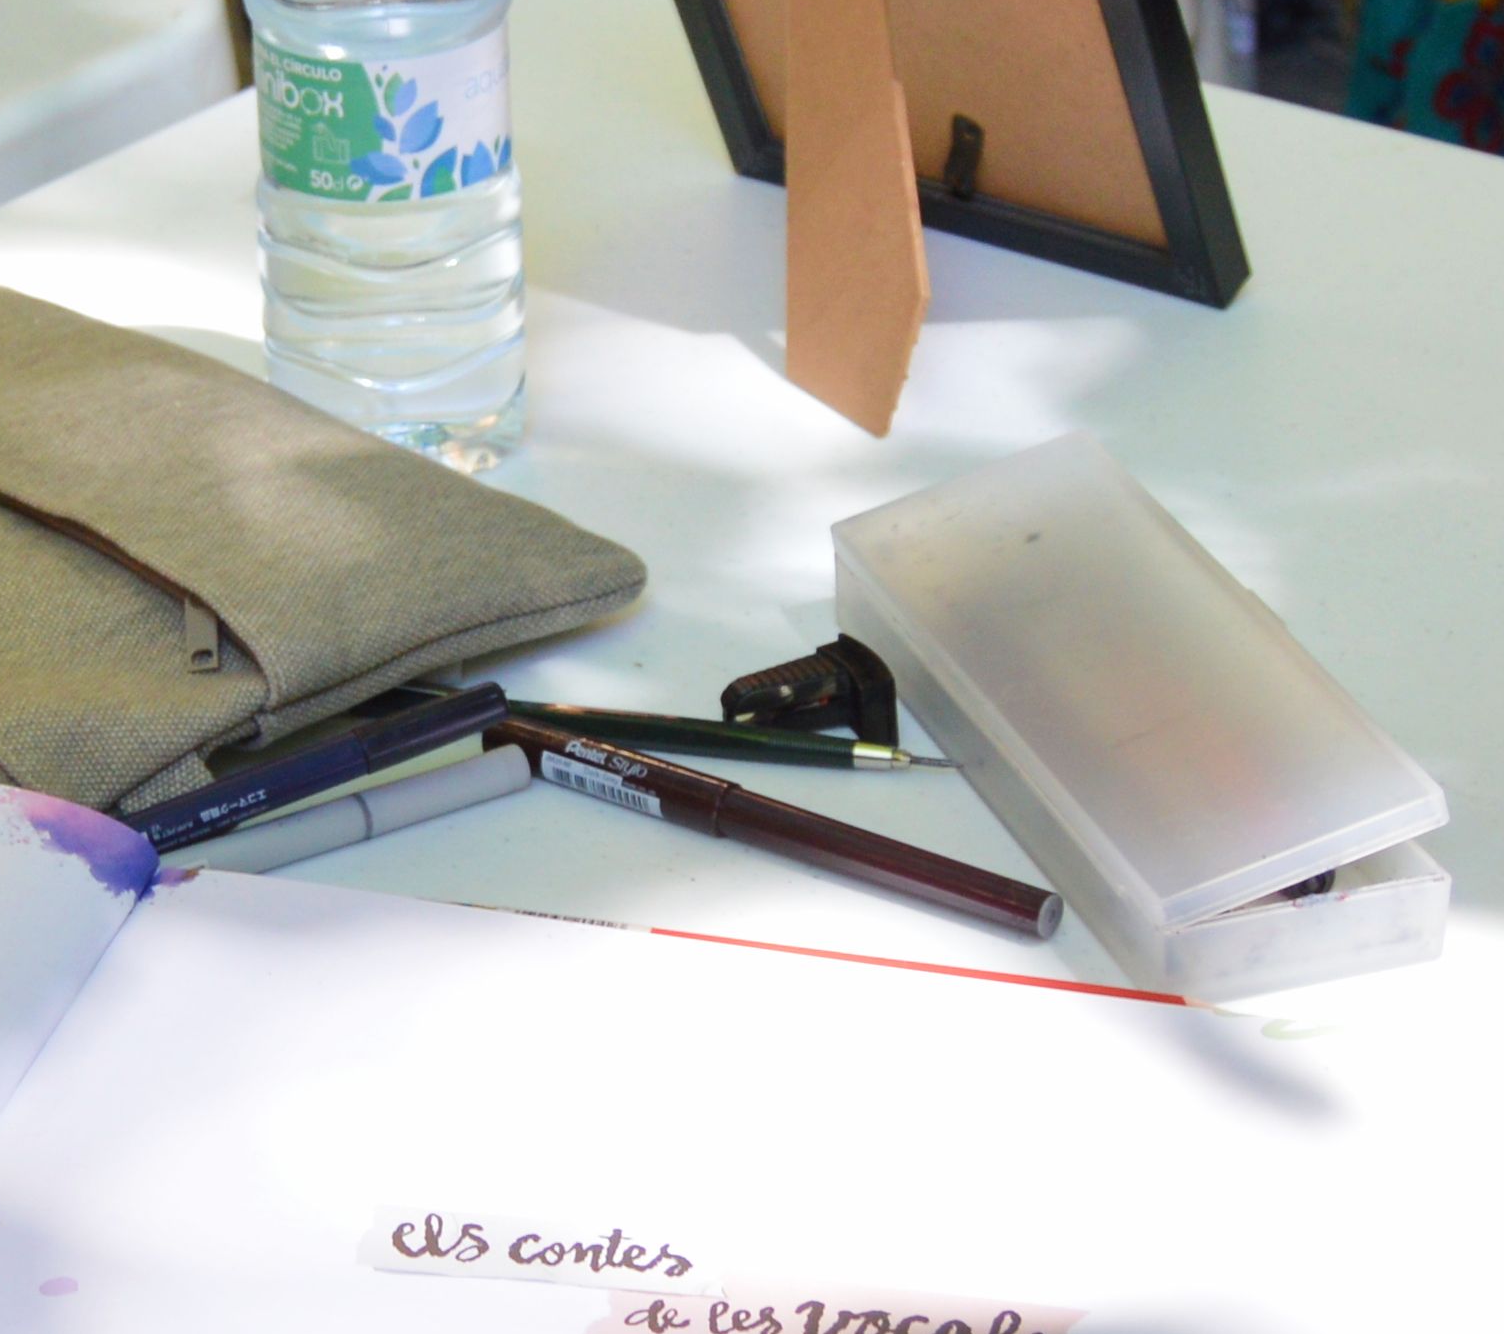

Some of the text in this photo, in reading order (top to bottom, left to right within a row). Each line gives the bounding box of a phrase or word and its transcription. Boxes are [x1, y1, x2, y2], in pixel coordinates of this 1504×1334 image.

[564, 739, 608, 765] Pentel
[391, 1213, 694, 1278] els contes
[623, 1299, 690, 1334] de
